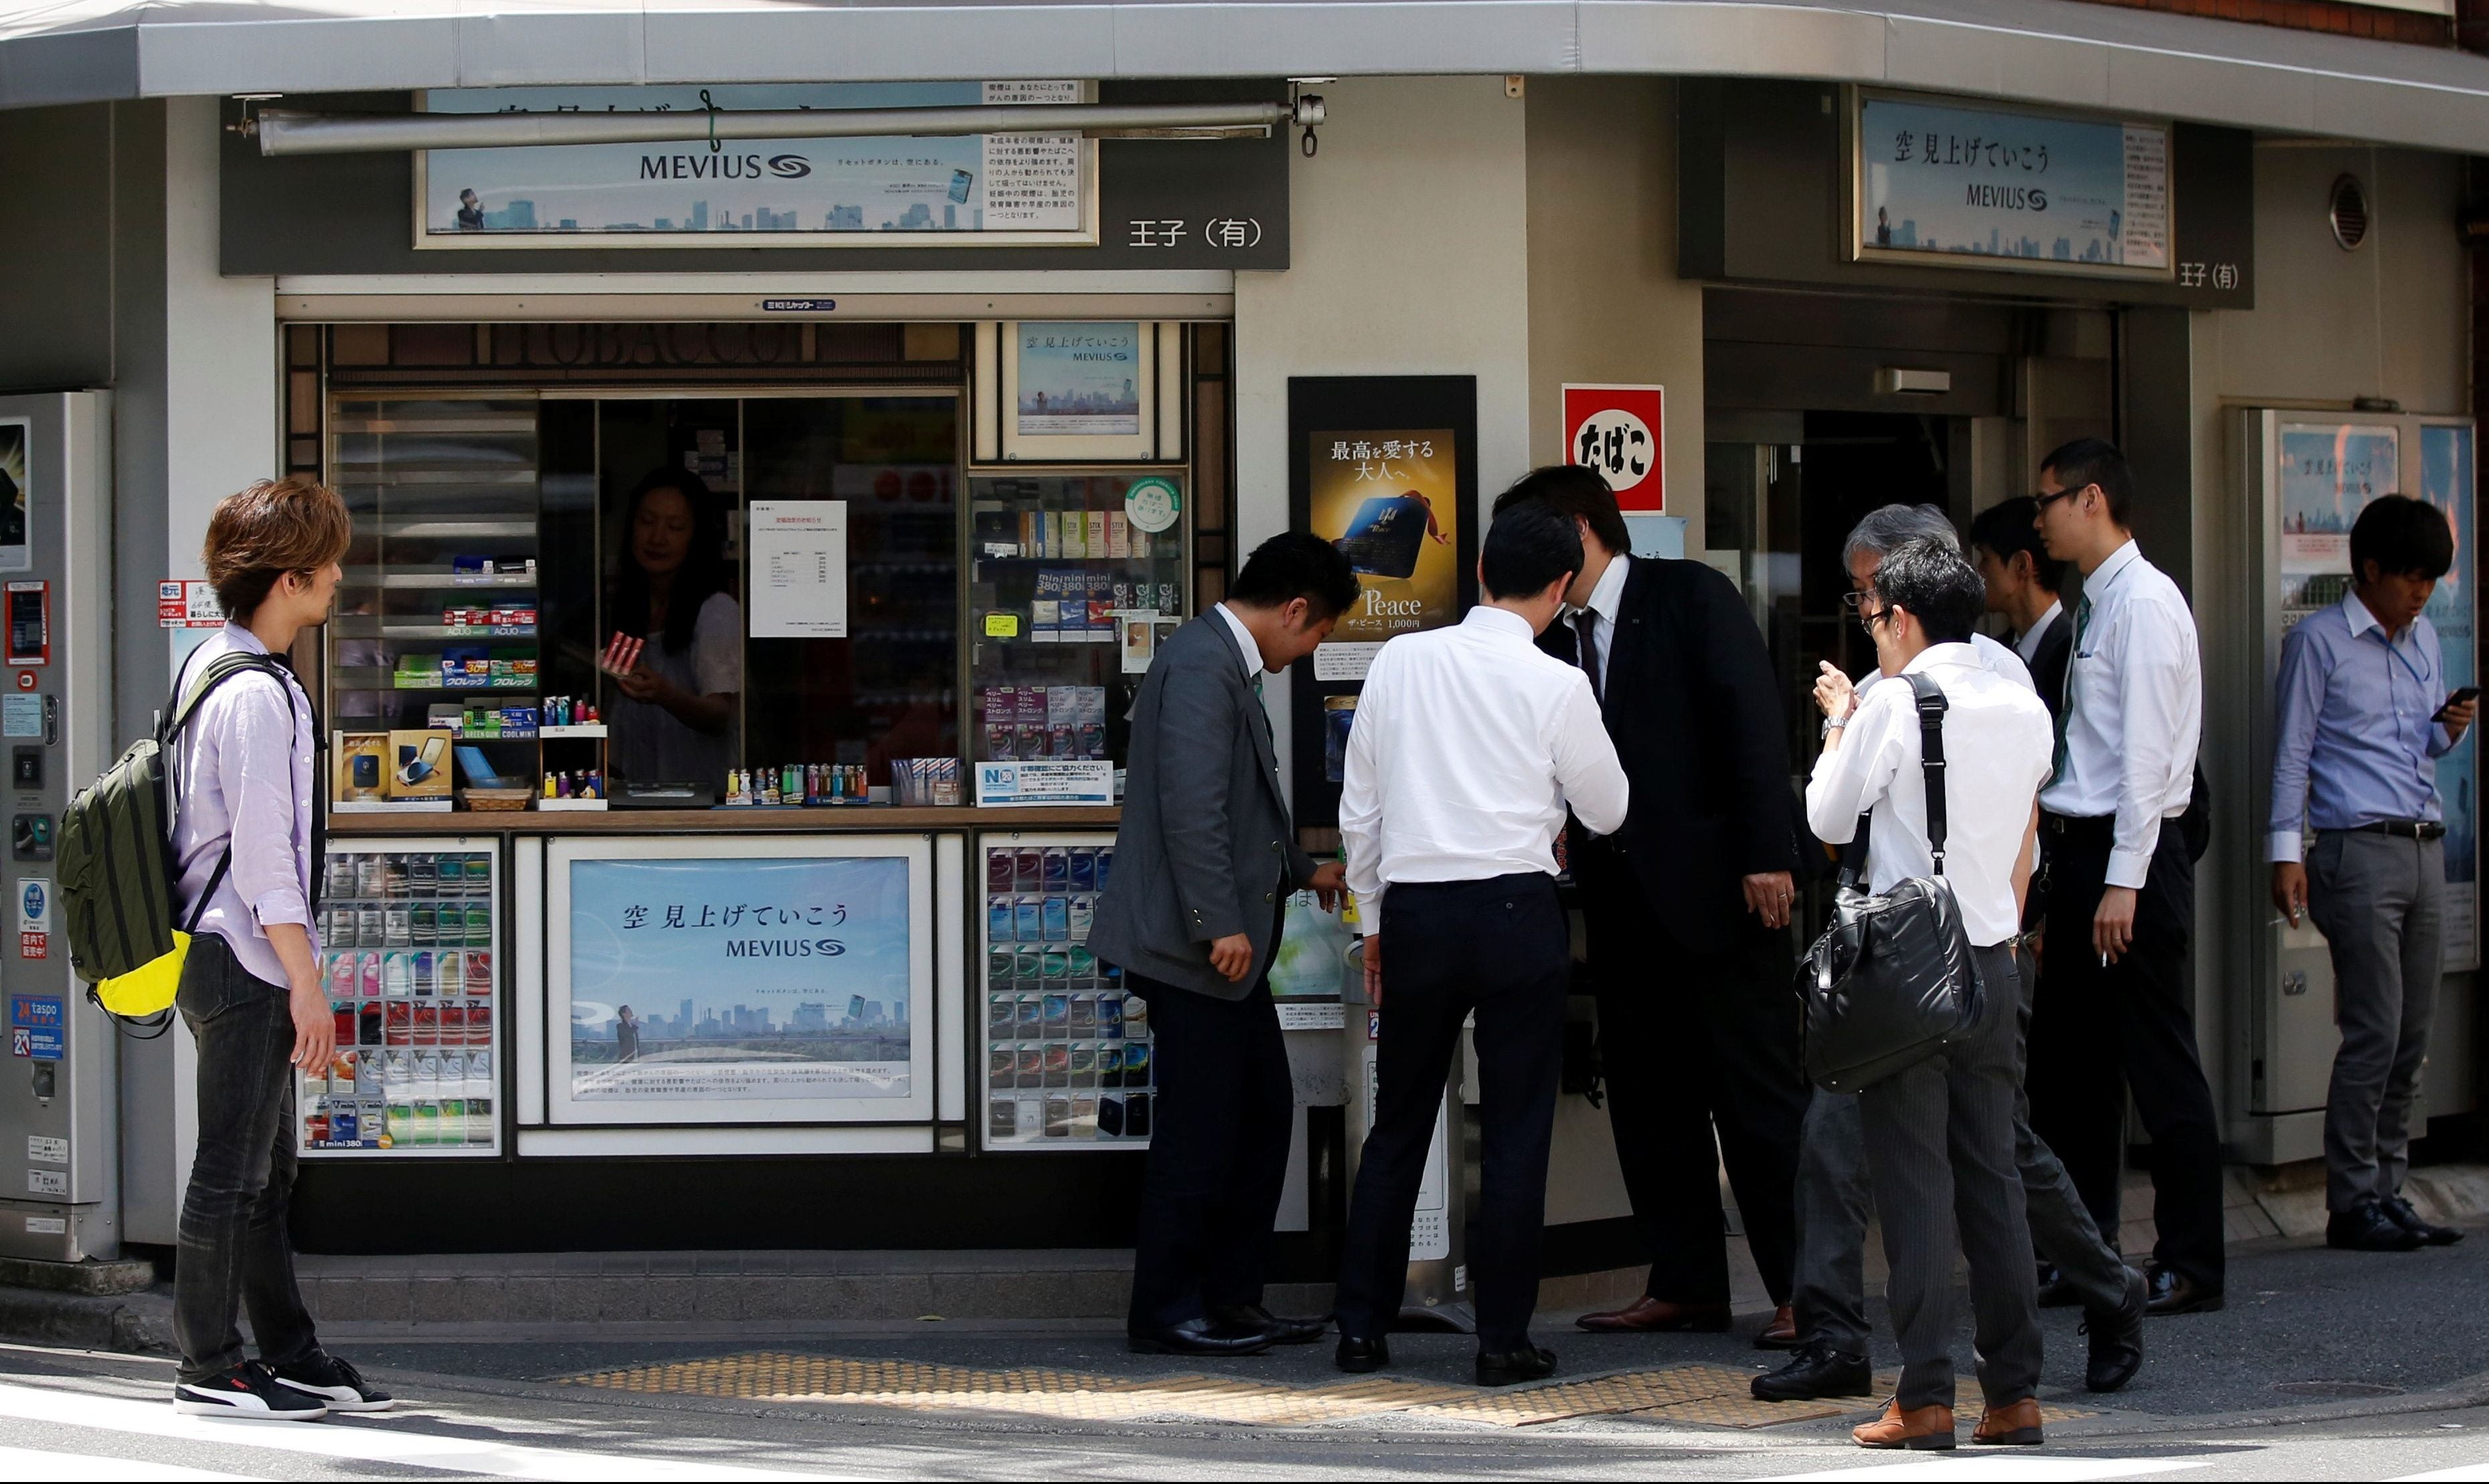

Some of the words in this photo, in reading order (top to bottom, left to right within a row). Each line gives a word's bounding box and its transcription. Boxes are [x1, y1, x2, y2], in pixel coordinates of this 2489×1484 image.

[1895, 130, 1913, 161] 空
[1922, 134, 2048, 173] 見上げていこう
[640, 155, 762, 180] MEVIUS
[1966, 183, 2025, 211] MEVIUS
[1026, 337, 1038, 349] 空
[1043, 336, 1129, 349] 見上げていこう
[1073, 353, 1112, 361] MEVIUS
[1331, 440, 1434, 460] 最高を愛する
[1581, 423, 1646, 476] たばこ
[1038, 573, 1063, 583] mini
[1087, 573, 1110, 582] mini
[1037, 580, 1059, 592] 380
[1062, 581, 1082, 591] 380
[1087, 581, 1108, 591] 380
[1365, 587, 1422, 616] Peace
[1347, 619, 1382, 627] ザ・ピース
[1388, 620, 1420, 628] 1,000円
[446, 678, 486, 686] クロレッツ
[493, 678, 533, 686] クロレッツ
[623, 905, 649, 929] 空
[660, 903, 847, 929] 見上げていこう
[726, 939, 811, 957] MEVIUS
[31, 1002, 57, 1016] taspo
